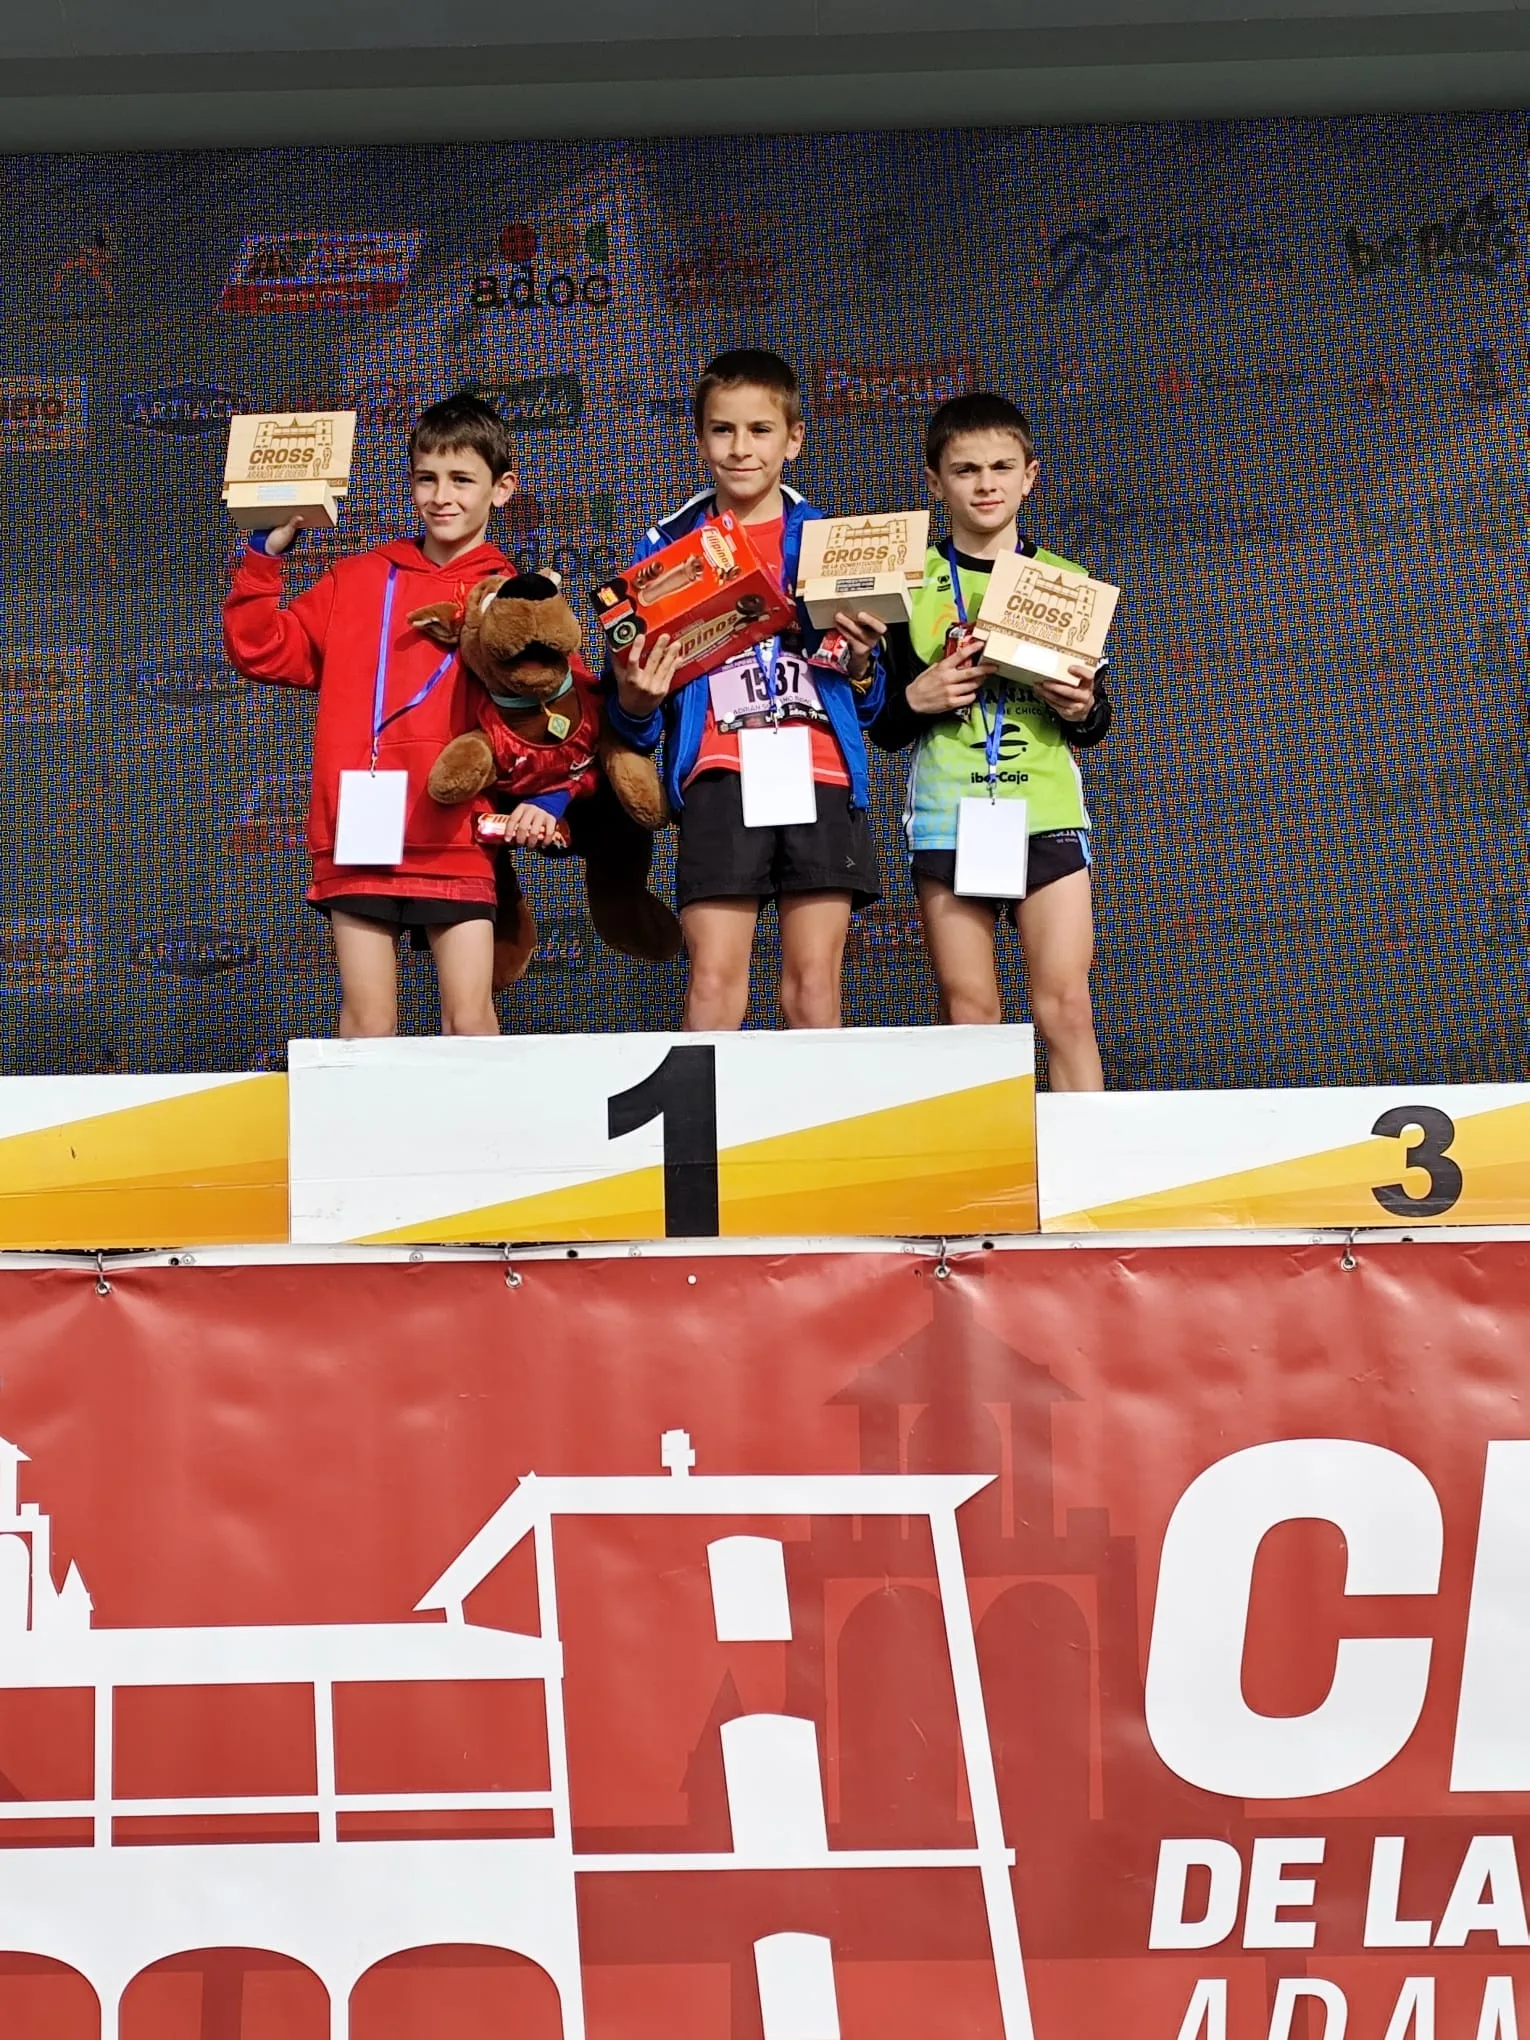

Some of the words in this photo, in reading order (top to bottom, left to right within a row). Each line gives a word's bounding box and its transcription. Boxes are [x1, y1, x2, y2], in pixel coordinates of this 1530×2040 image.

[470, 263, 612, 309] adoc
[249, 447, 315, 465] CROSS
[702, 526, 732, 569] Filipinos
[823, 545, 889, 564] CROSS
[1006, 594, 1073, 628] CROSS
[740, 660, 800, 703] 1537
[607, 1044, 719, 1238] 1
[1371, 1104, 1463, 1218] 3
[1148, 1837, 1326, 1949] DE
[1363, 1835, 1530, 1948] LA
